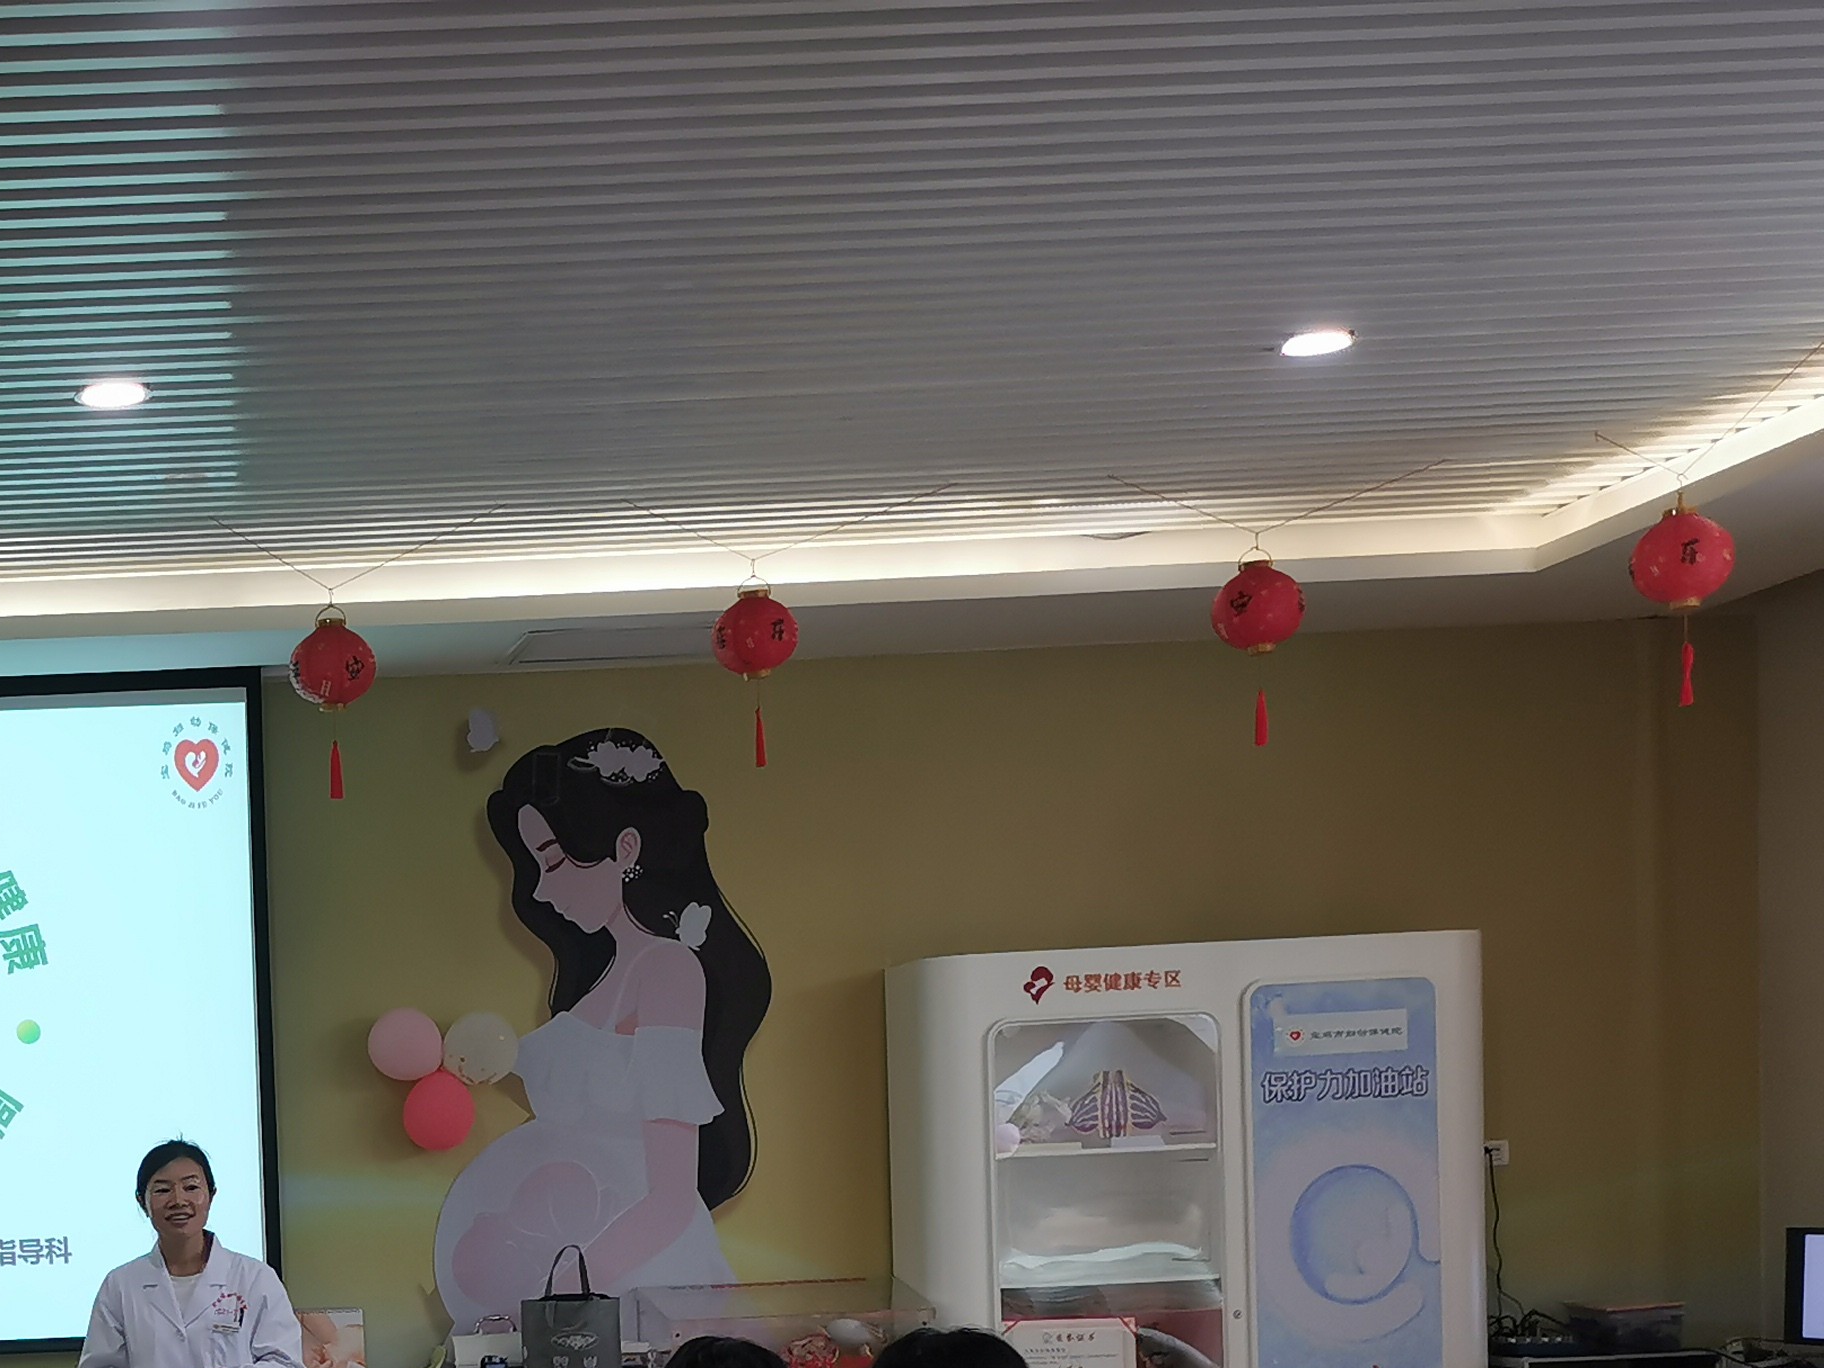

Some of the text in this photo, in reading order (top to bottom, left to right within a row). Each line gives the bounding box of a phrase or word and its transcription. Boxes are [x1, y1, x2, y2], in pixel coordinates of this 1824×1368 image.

[1063, 969, 1182, 994] 母婴健康专区
[1260, 1064, 1430, 1104] 保护力加油站
